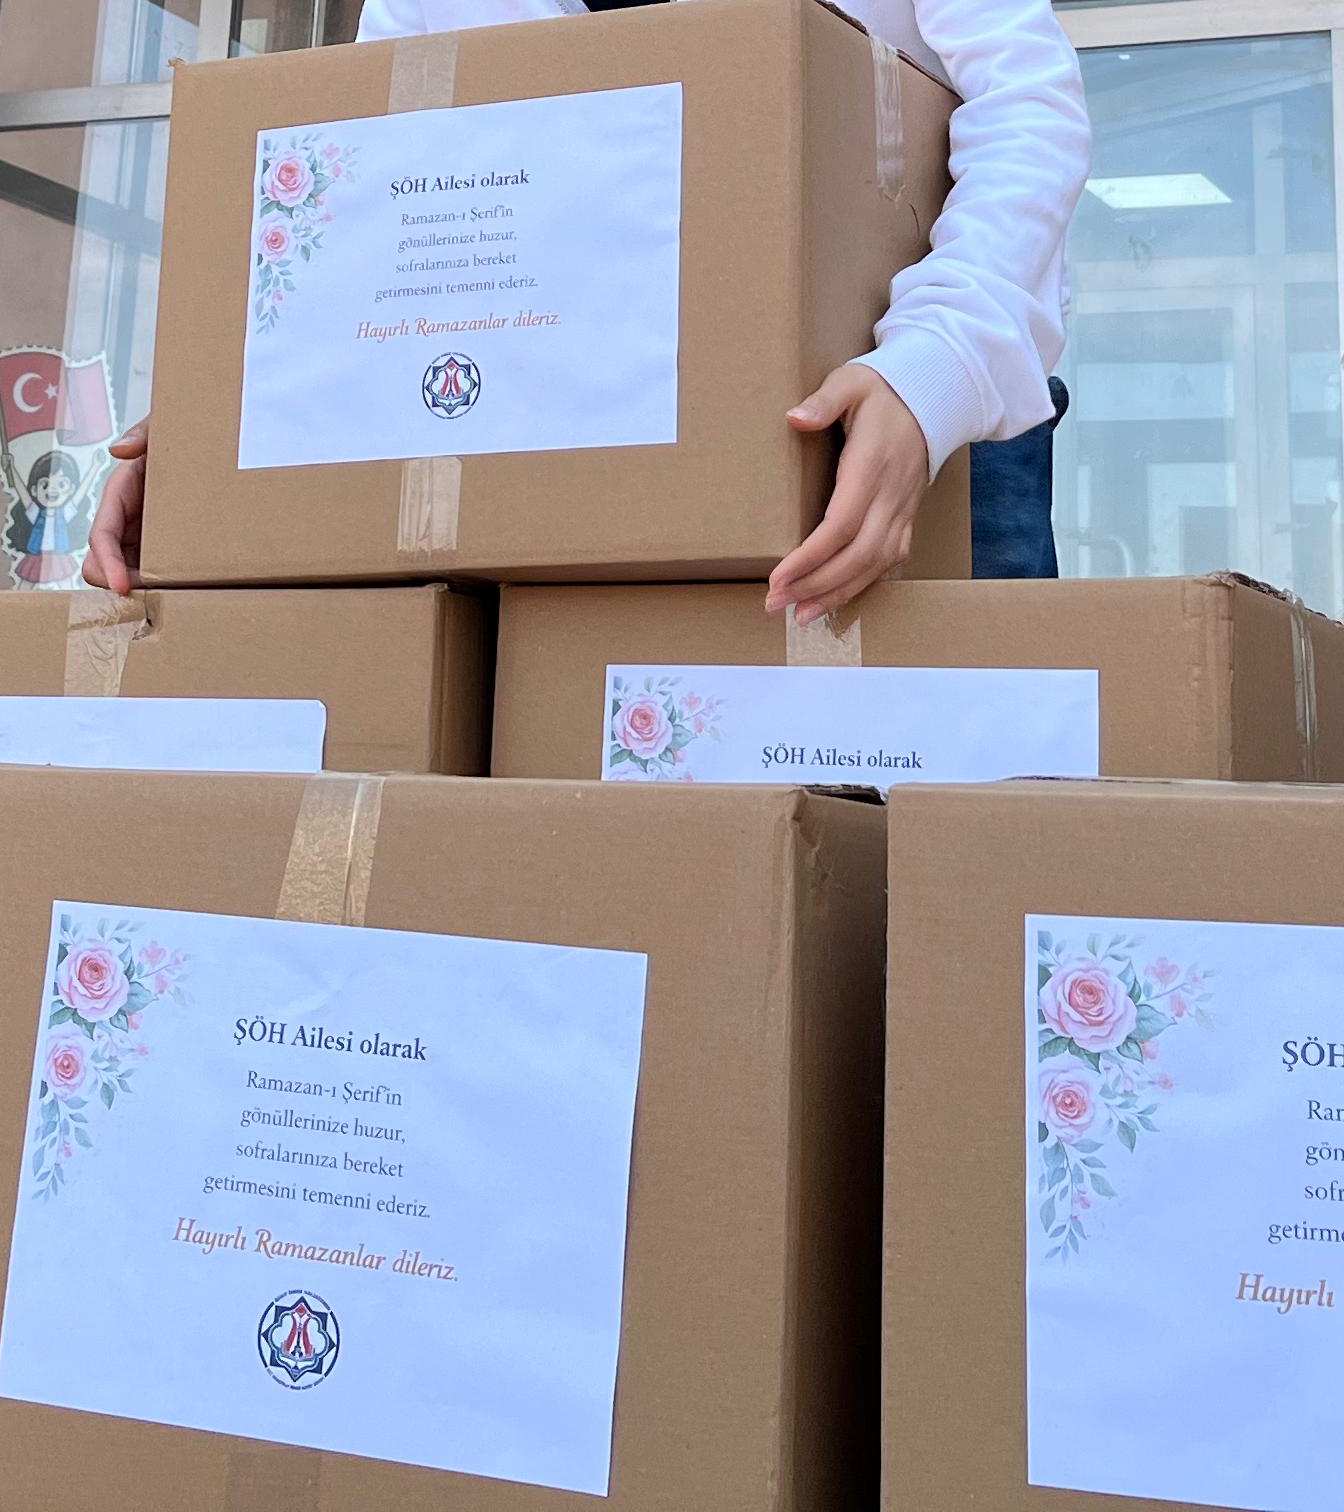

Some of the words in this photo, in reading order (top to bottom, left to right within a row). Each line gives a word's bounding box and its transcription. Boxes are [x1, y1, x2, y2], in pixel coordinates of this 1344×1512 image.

[391, 176, 428, 200] ŞÖH
[431, 174, 475, 192] Ailesi
[481, 169, 529, 187] olarak
[473, 251, 516, 267] bereket
[375, 282, 442, 302] getirmesini
[446, 279, 494, 295] temenni
[357, 320, 409, 344] Hayırlı
[415, 313, 508, 336] Ramazanlar
[762, 743, 805, 768] ŞÖH
[810, 748, 861, 767] Ailesi
[867, 750, 922, 768] olarak
[234, 1016, 287, 1045] ŞÖH
[291, 1026, 353, 1052] Ailesi
[360, 1033, 426, 1060] olarak
[246, 1071, 336, 1097] Ramazan-ı
[240, 1107, 348, 1134] gönüllerinize
[353, 1118, 405, 1144] huzur,
[236, 1140, 338, 1168] sofralarınıza
[344, 1152, 402, 1177] bereket
[203, 1173, 297, 1202] getirmesini
[302, 1187, 371, 1211] temenni
[377, 1195, 430, 1218] ederiz.
[172, 1217, 247, 1253] Hayırlı
[255, 1229, 386, 1271] Ramazanlar
[388, 1250, 457, 1281] dileriz.
[1236, 1272, 1335, 1315] Hayırlı
